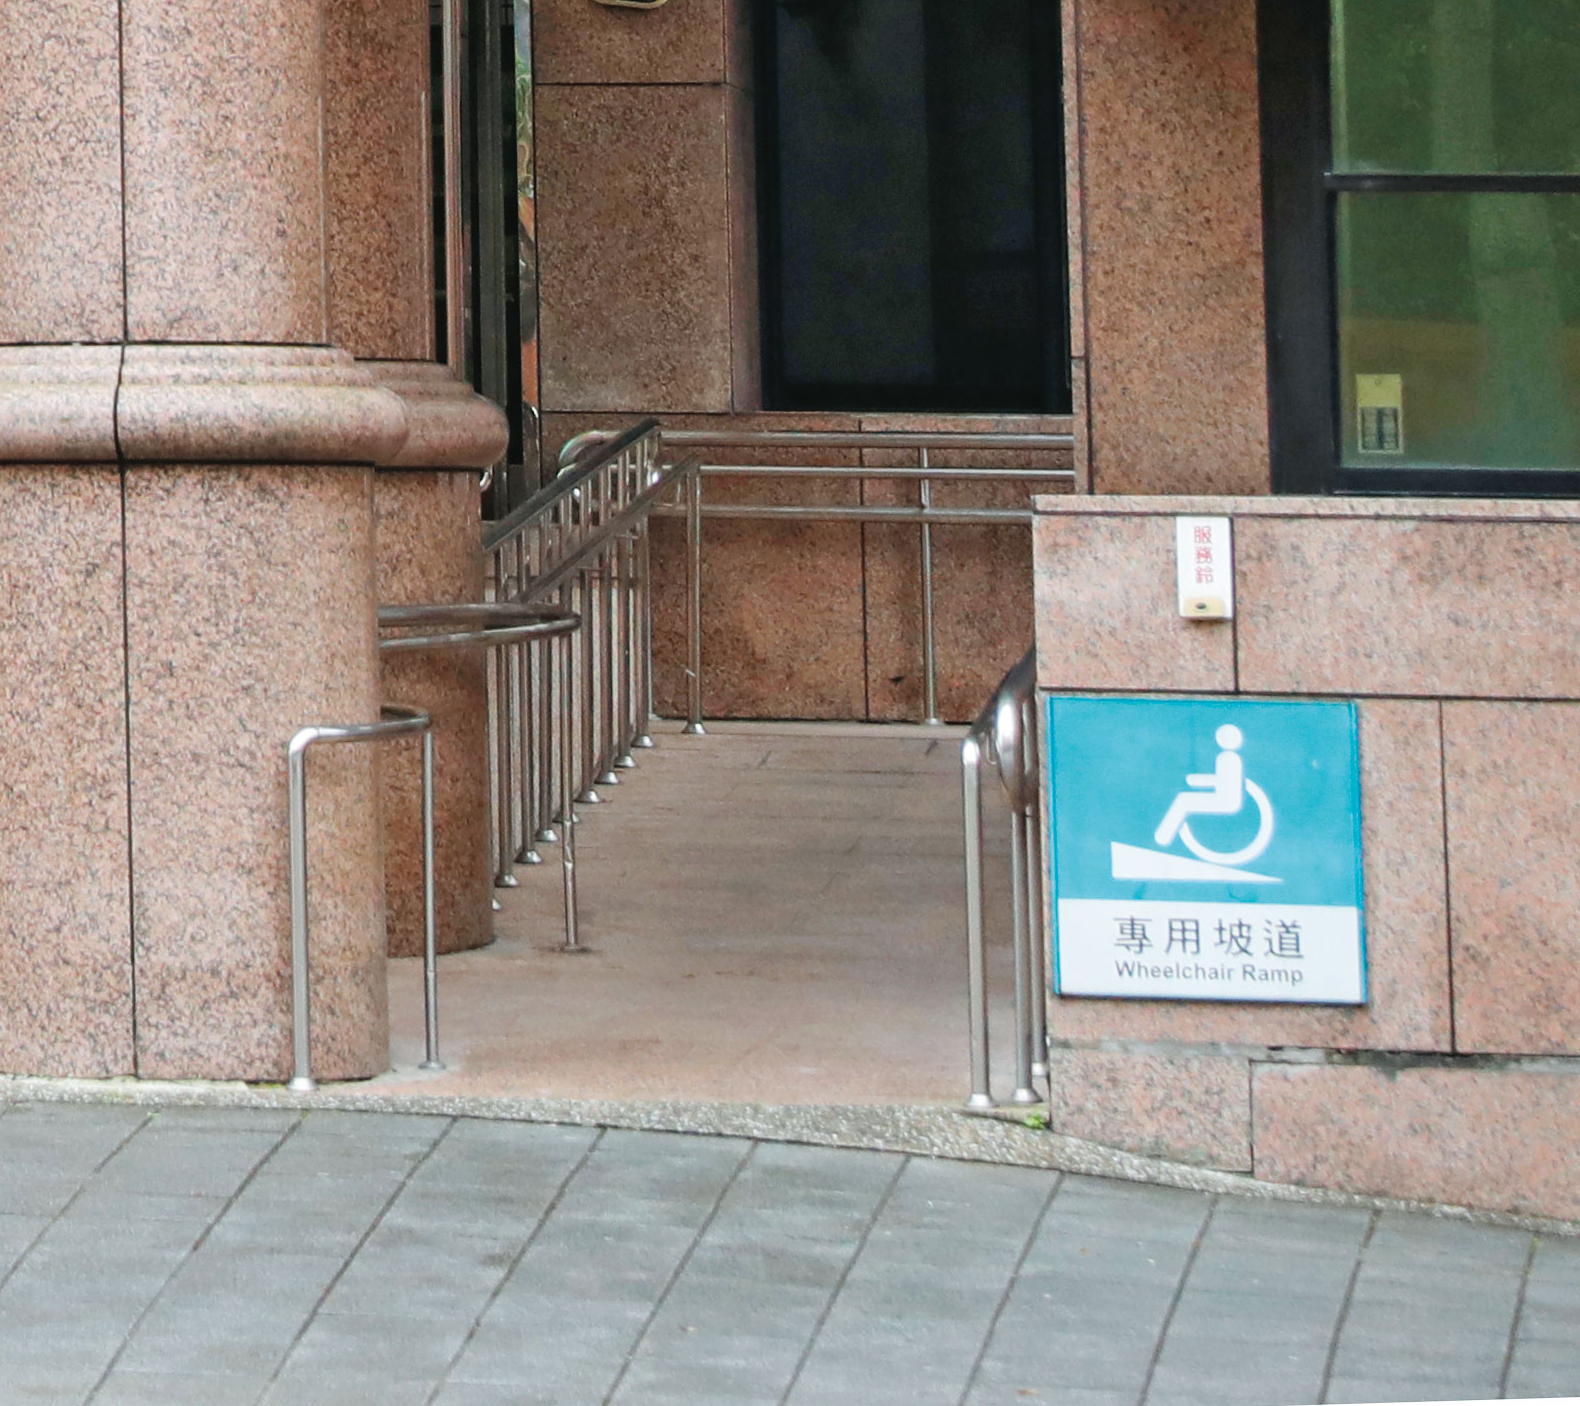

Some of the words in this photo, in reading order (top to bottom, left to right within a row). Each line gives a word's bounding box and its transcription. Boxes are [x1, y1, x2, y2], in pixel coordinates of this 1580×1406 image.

[1112, 915, 1305, 960] 專用坡道
[1114, 959, 1236, 982] Wheelchair
[1242, 963, 1305, 987] Ramp
